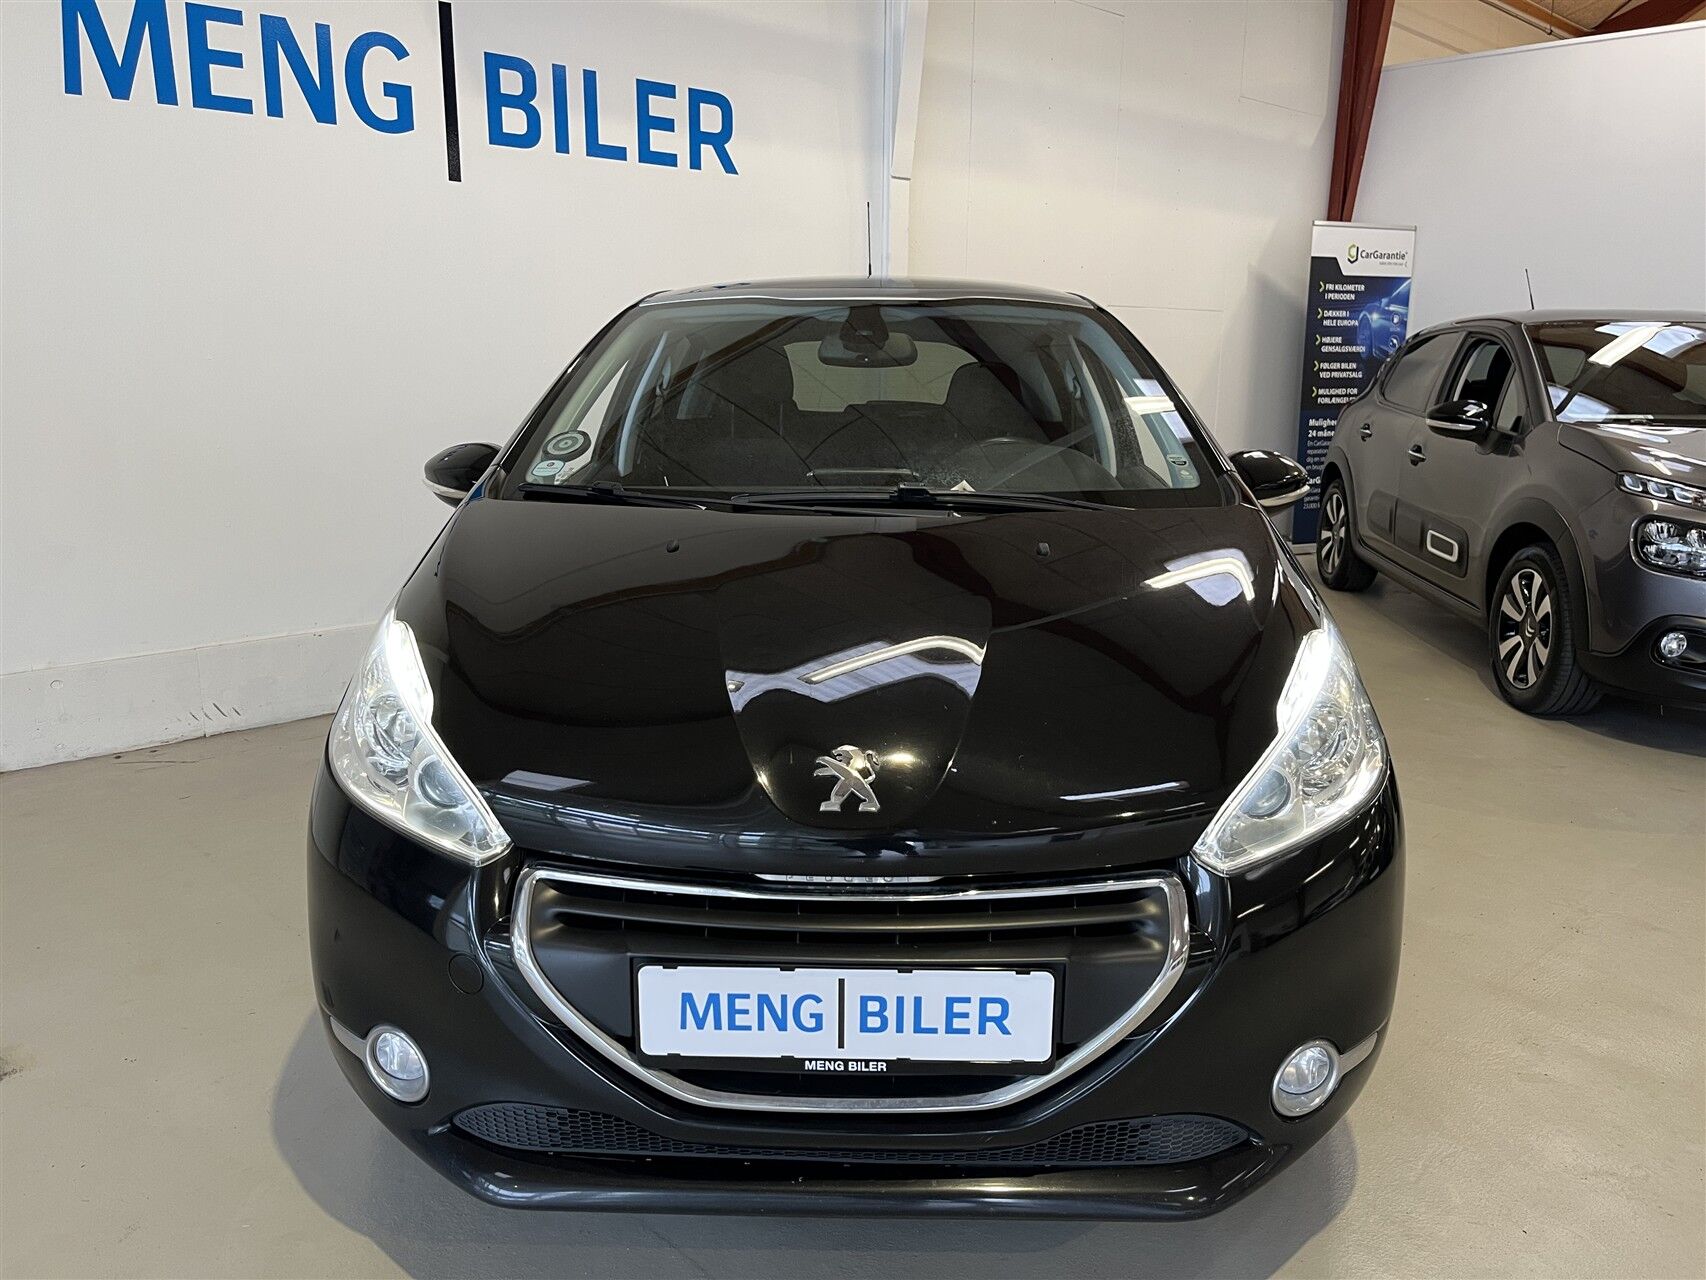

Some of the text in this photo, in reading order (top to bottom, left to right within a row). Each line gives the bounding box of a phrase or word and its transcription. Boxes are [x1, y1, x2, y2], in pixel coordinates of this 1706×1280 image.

[61, 0, 739, 175] MENG BILER
[1360, 249, 1406, 261] CarGarantie
[1326, 283, 1365, 292] FRI KILOMETER
[1338, 319, 1358, 327] EUROPA
[1322, 336, 1342, 344] HØJERE
[1341, 362, 1357, 370] BILEN
[1308, 429, 1316, 437] 24
[680, 992, 1012, 1036] MENG BILER
[804, 1060, 887, 1072] MENG BILER
